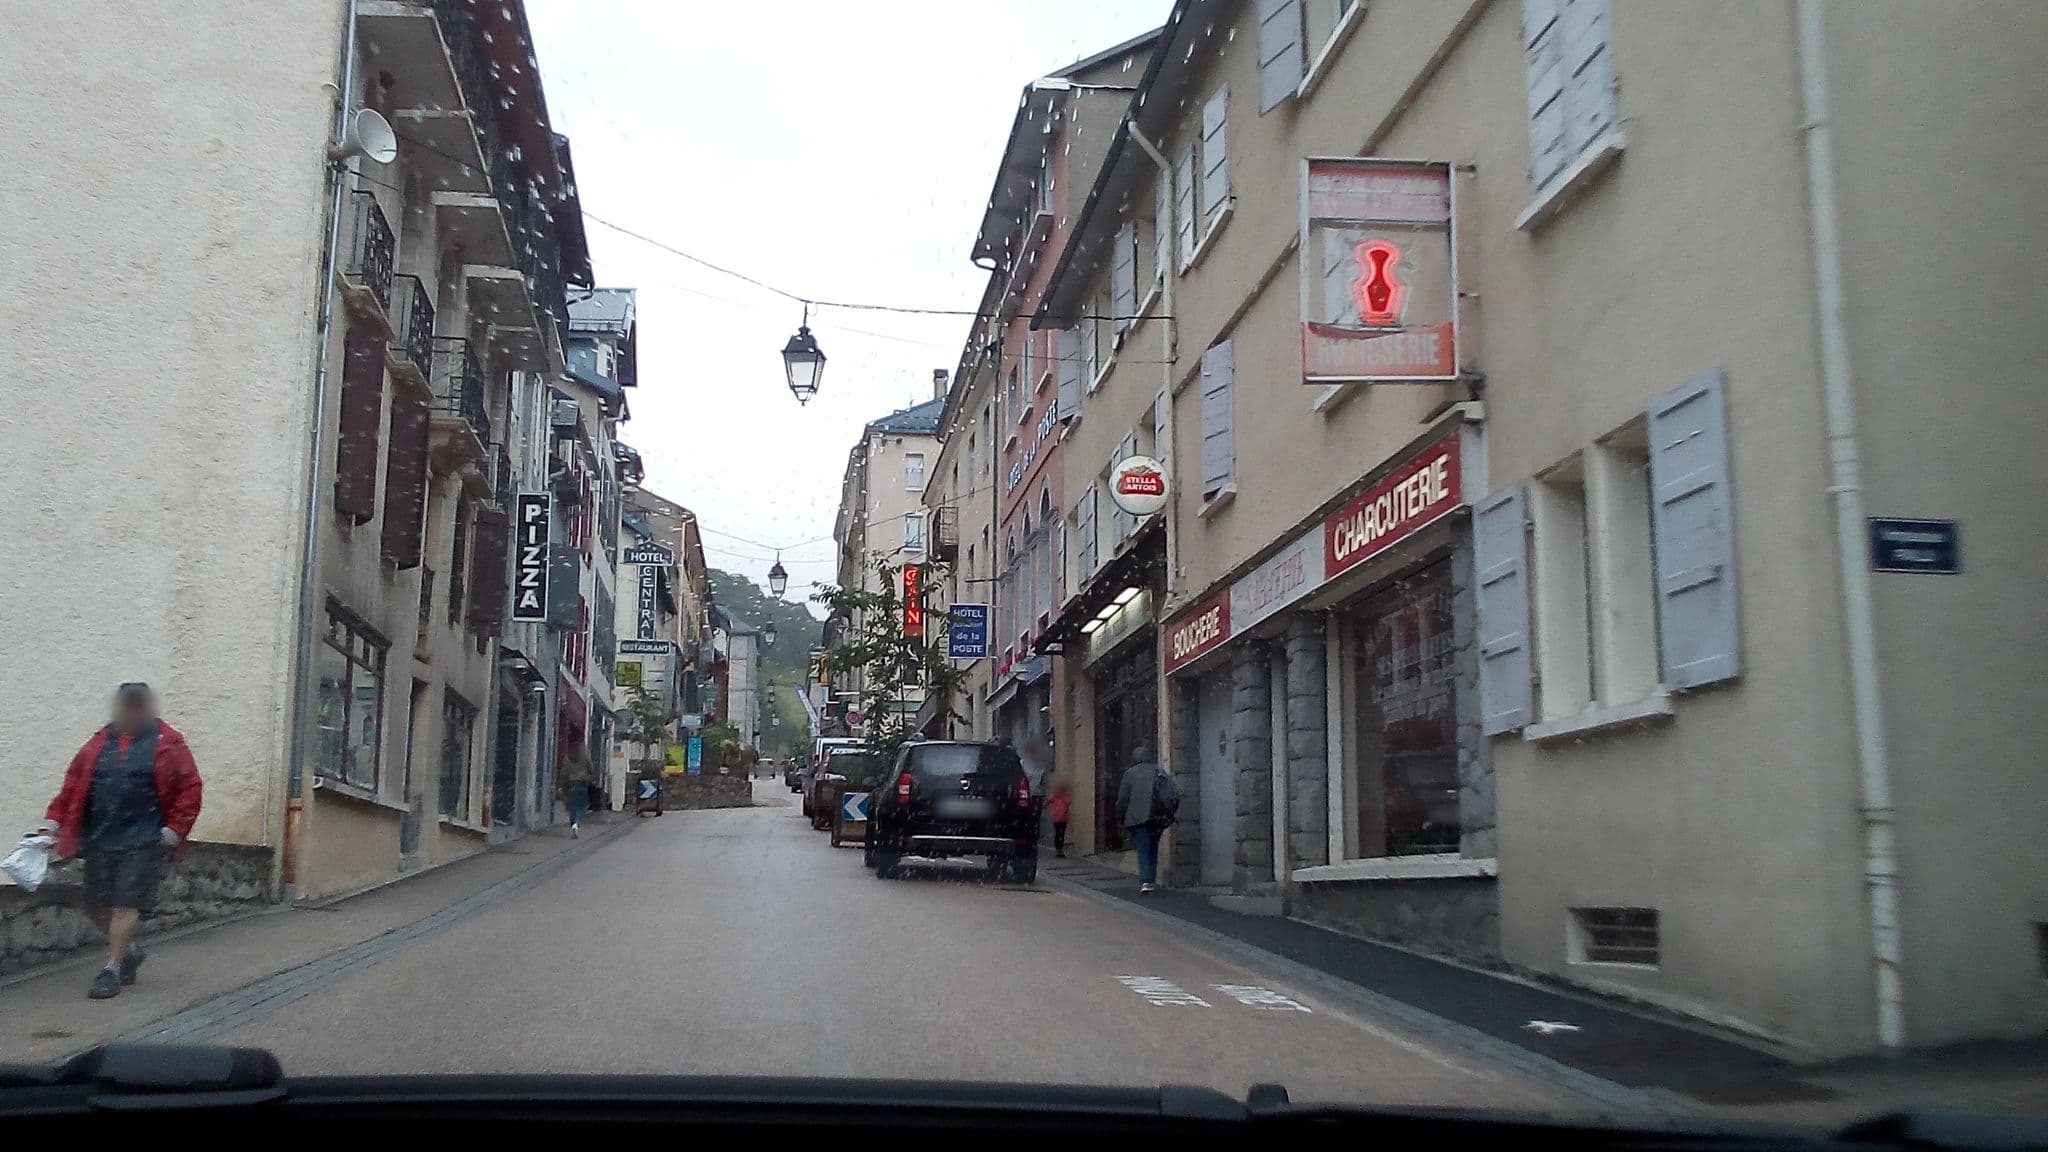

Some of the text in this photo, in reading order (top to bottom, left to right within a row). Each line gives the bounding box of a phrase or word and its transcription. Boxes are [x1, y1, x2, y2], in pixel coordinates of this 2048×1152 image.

[1125, 476, 1157, 484] STELLA
[1124, 483, 1157, 491] ARTOIS
[1334, 454, 1449, 561] CHARCUTERIE
[519, 504, 542, 608] PIZZA
[630, 552, 664, 563] HOTEL
[641, 566, 654, 639] CENTRAL
[957, 632, 980, 640] de la
[1173, 606, 1220, 660] BOUCHERIE
[621, 643, 668, 653] RESTAURANT
[952, 644, 984, 653] POSTE
